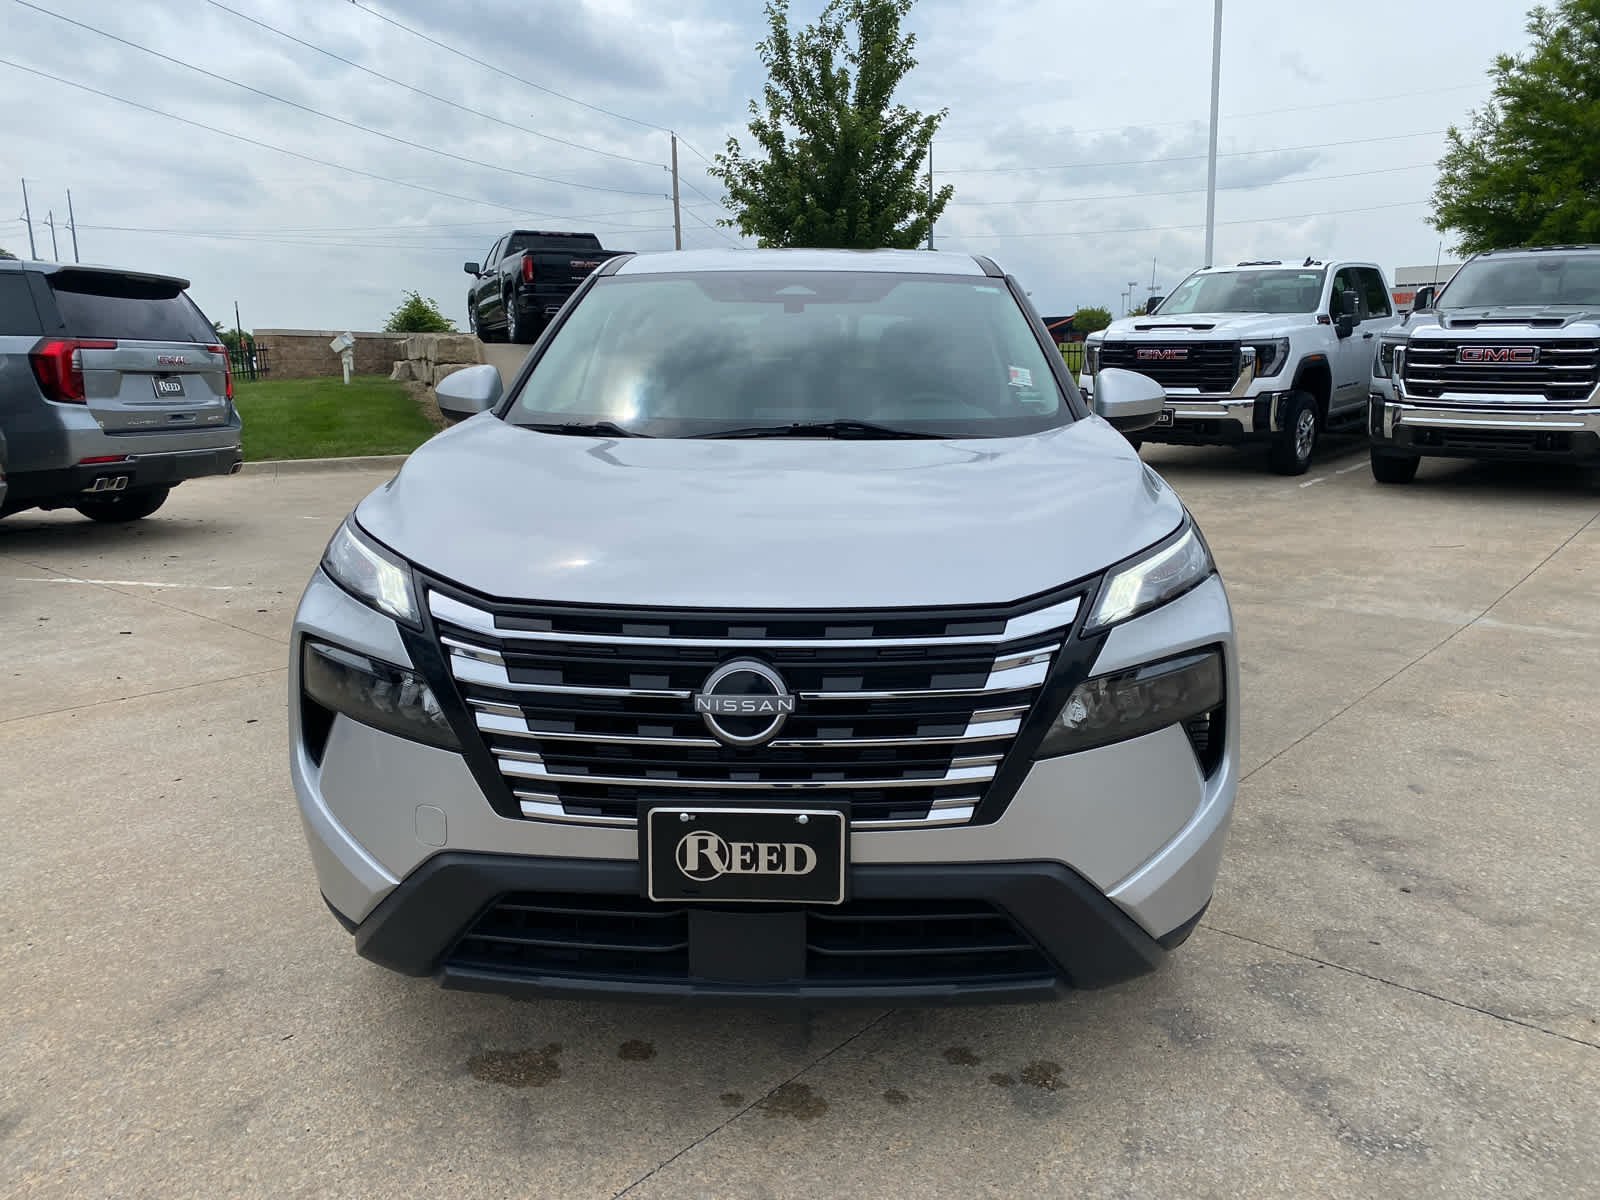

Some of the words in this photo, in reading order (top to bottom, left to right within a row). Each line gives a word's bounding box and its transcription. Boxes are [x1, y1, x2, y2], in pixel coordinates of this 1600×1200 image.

[1136, 349, 1188, 360] GMC
[1462, 348, 1533, 361] GMC
[159, 381, 181, 392] REED
[697, 698, 793, 712] NISSAN
[682, 835, 817, 875] REED
